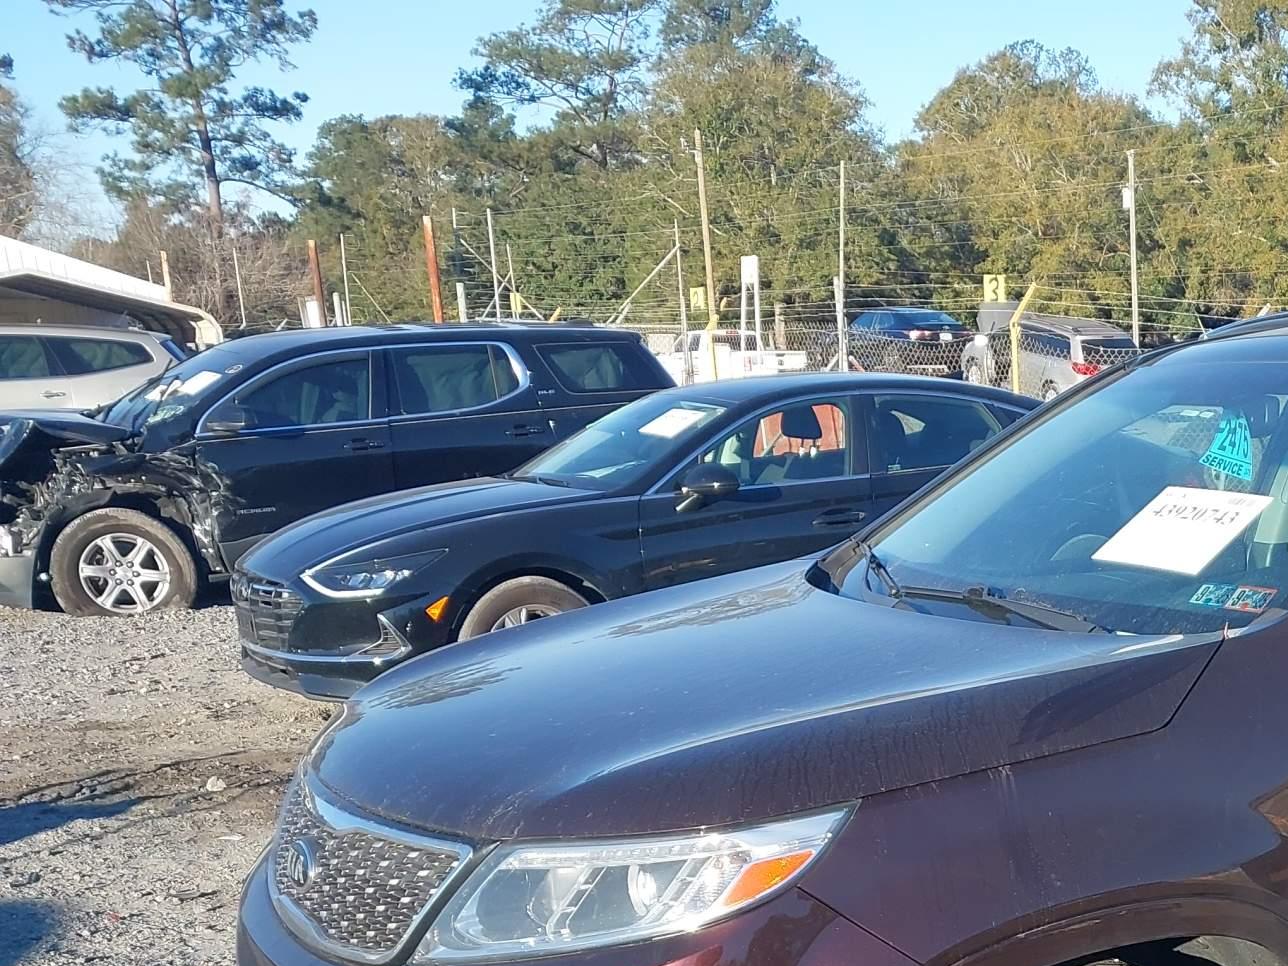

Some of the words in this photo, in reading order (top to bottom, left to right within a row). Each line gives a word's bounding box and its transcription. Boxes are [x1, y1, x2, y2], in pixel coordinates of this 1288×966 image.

[988, 277, 999, 301] 3
[1202, 454, 1244, 476] SERVICE
[1153, 504, 1240, 526] 43920743
